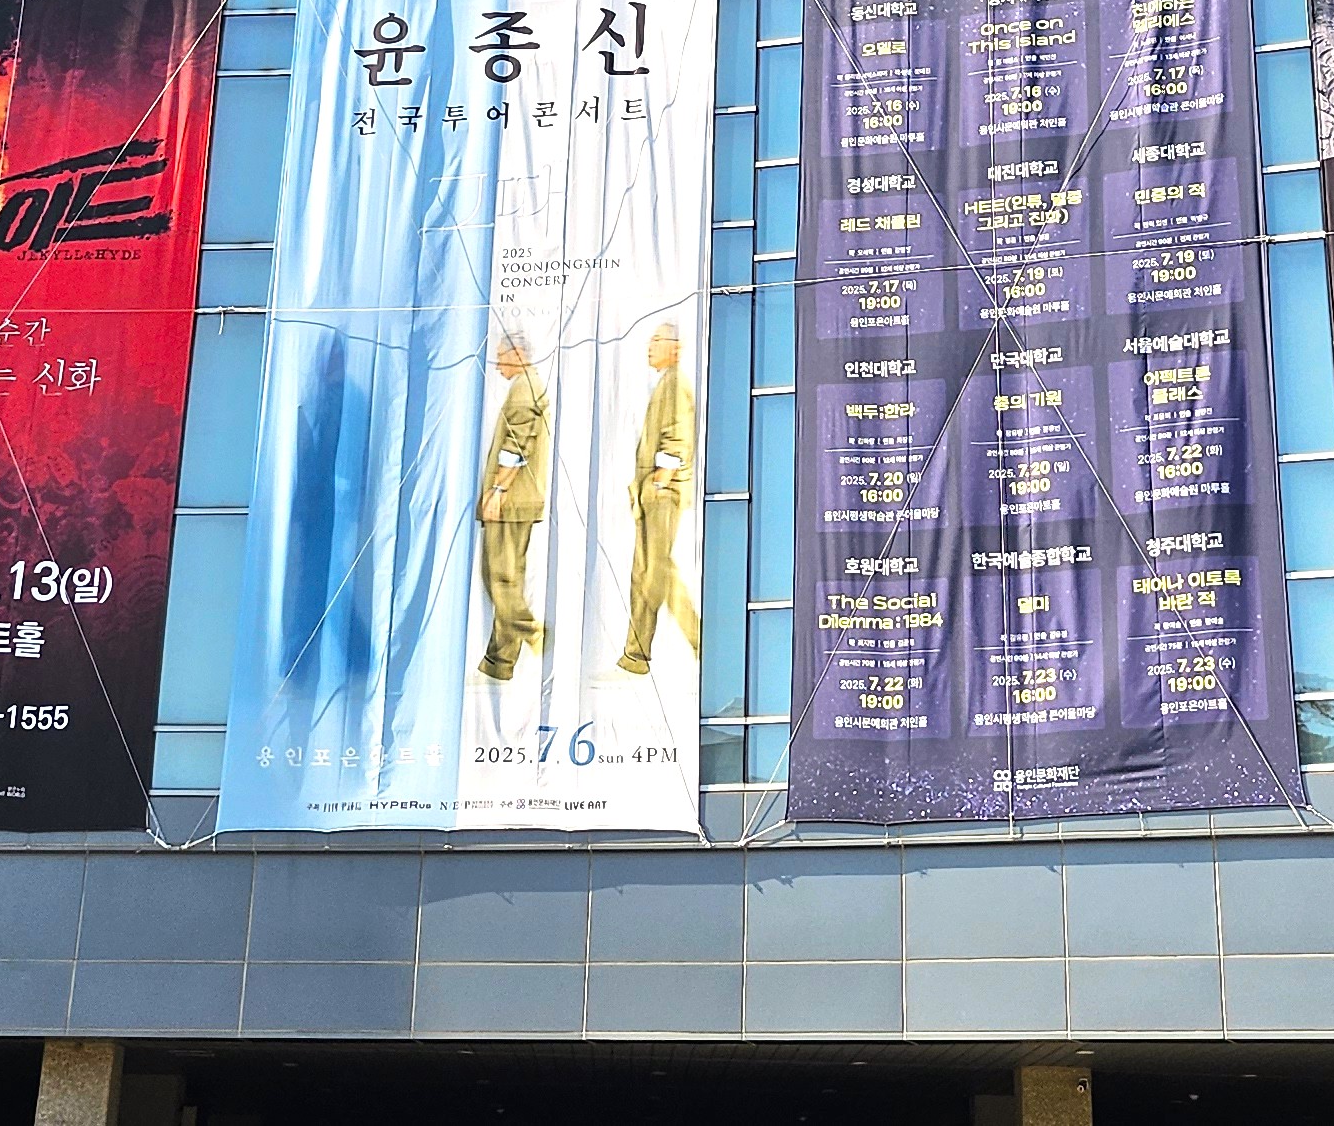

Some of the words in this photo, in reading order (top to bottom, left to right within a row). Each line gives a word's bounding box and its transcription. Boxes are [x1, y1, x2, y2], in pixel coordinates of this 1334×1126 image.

[980, 20, 1031, 36] Once
[1036, 18, 1063, 29] on
[968, 38, 1011, 54] This
[1016, 30, 1076, 48] Island
[1143, 82, 1187, 97] 16:00
[863, 115, 903, 129] 16:00
[1132, 141, 1206, 164] 세종대학교
[988, 161, 1058, 182] 대진대학교
[847, 175, 916, 194] 경성대학교
[1188, 183, 1206, 198] 적
[840, 217, 871, 232] 레드
[977, 214, 1024, 231] 그리고
[503, 248, 532, 258] 2025
[501, 259, 620, 273] YOONJONGSHIN
[1150, 266, 1196, 282] 19:00
[501, 275, 569, 287] CONCERT
[501, 294, 514, 302] IN
[1003, 282, 1045, 299] 16:00
[859, 295, 901, 310] 19:00
[1123, 329, 1230, 355] 서울예술대학교
[991, 347, 1063, 369] 단국대학교
[844, 359, 917, 378] 인천대학교
[38, 358, 102, 397] 신화
[1029, 390, 1062, 406] 기원
[1157, 462, 1203, 479] 16:00
[1009, 478, 1050, 495] 19:00
[860, 489, 903, 503] 16:00
[1146, 532, 1223, 557] 청주대학교
[845, 557, 919, 576] 호원대학교
[972, 546, 1092, 570] 한국예술종합학교
[1133, 574, 1184, 594] 태어나
[1187, 570, 1241, 588] 이토록
[828, 595, 869, 610] The
[873, 592, 937, 610] Social
[1159, 593, 1193, 611] 바란
[1198, 591, 1216, 607] 적
[1168, 675, 1215, 692] 19:00
[859, 694, 904, 709] 19:00
[1012, 686, 1056, 703] 16:00
[1014, 766, 1079, 783] 용인문화재단
[565, 801, 584, 810] LIVE
[588, 801, 607, 810] ART
